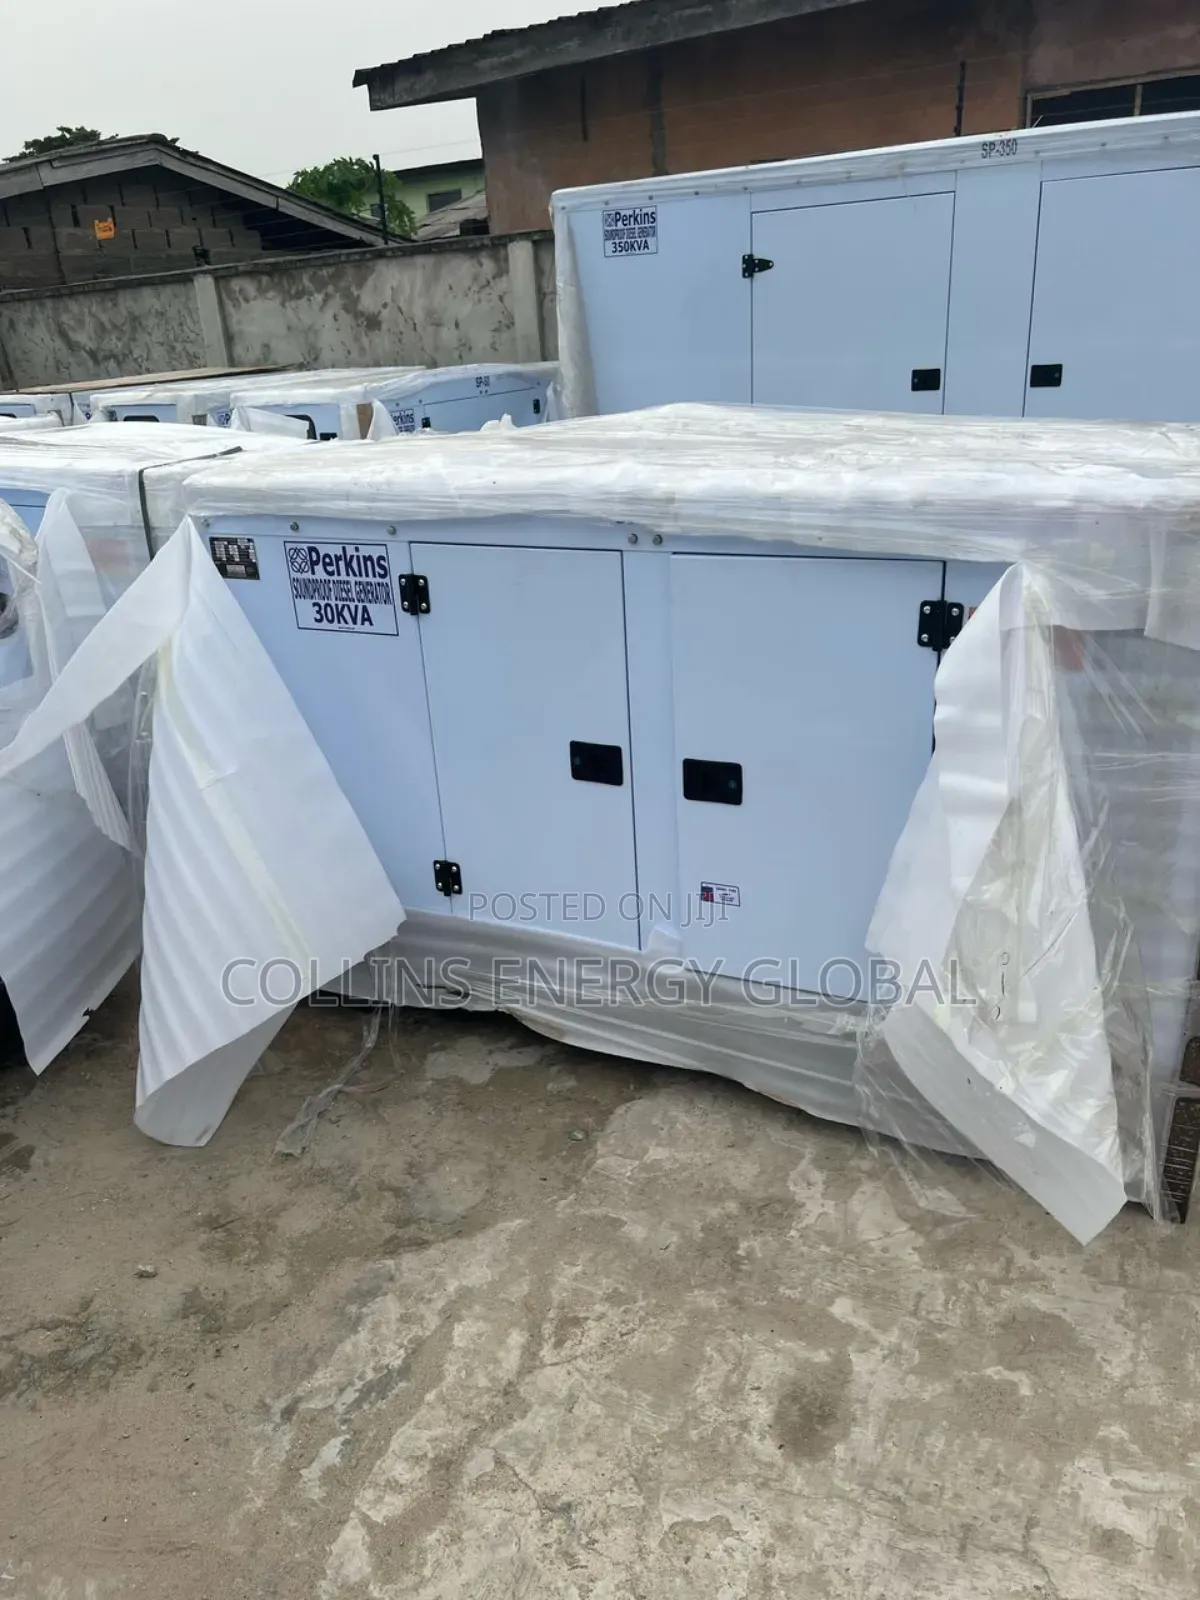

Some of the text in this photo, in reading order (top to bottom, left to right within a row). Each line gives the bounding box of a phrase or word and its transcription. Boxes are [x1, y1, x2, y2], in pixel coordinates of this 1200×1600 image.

[981, 138, 1018, 159] SP-350
[614, 209, 656, 227] Perkins
[611, 240, 650, 254] 350KVA
[391, 410, 415, 425] erkins
[307, 545, 388, 579] Perkins
[292, 577, 393, 605] SOUNDPROOF DIESEL GENERATOR
[312, 601, 374, 627] 30KVA
